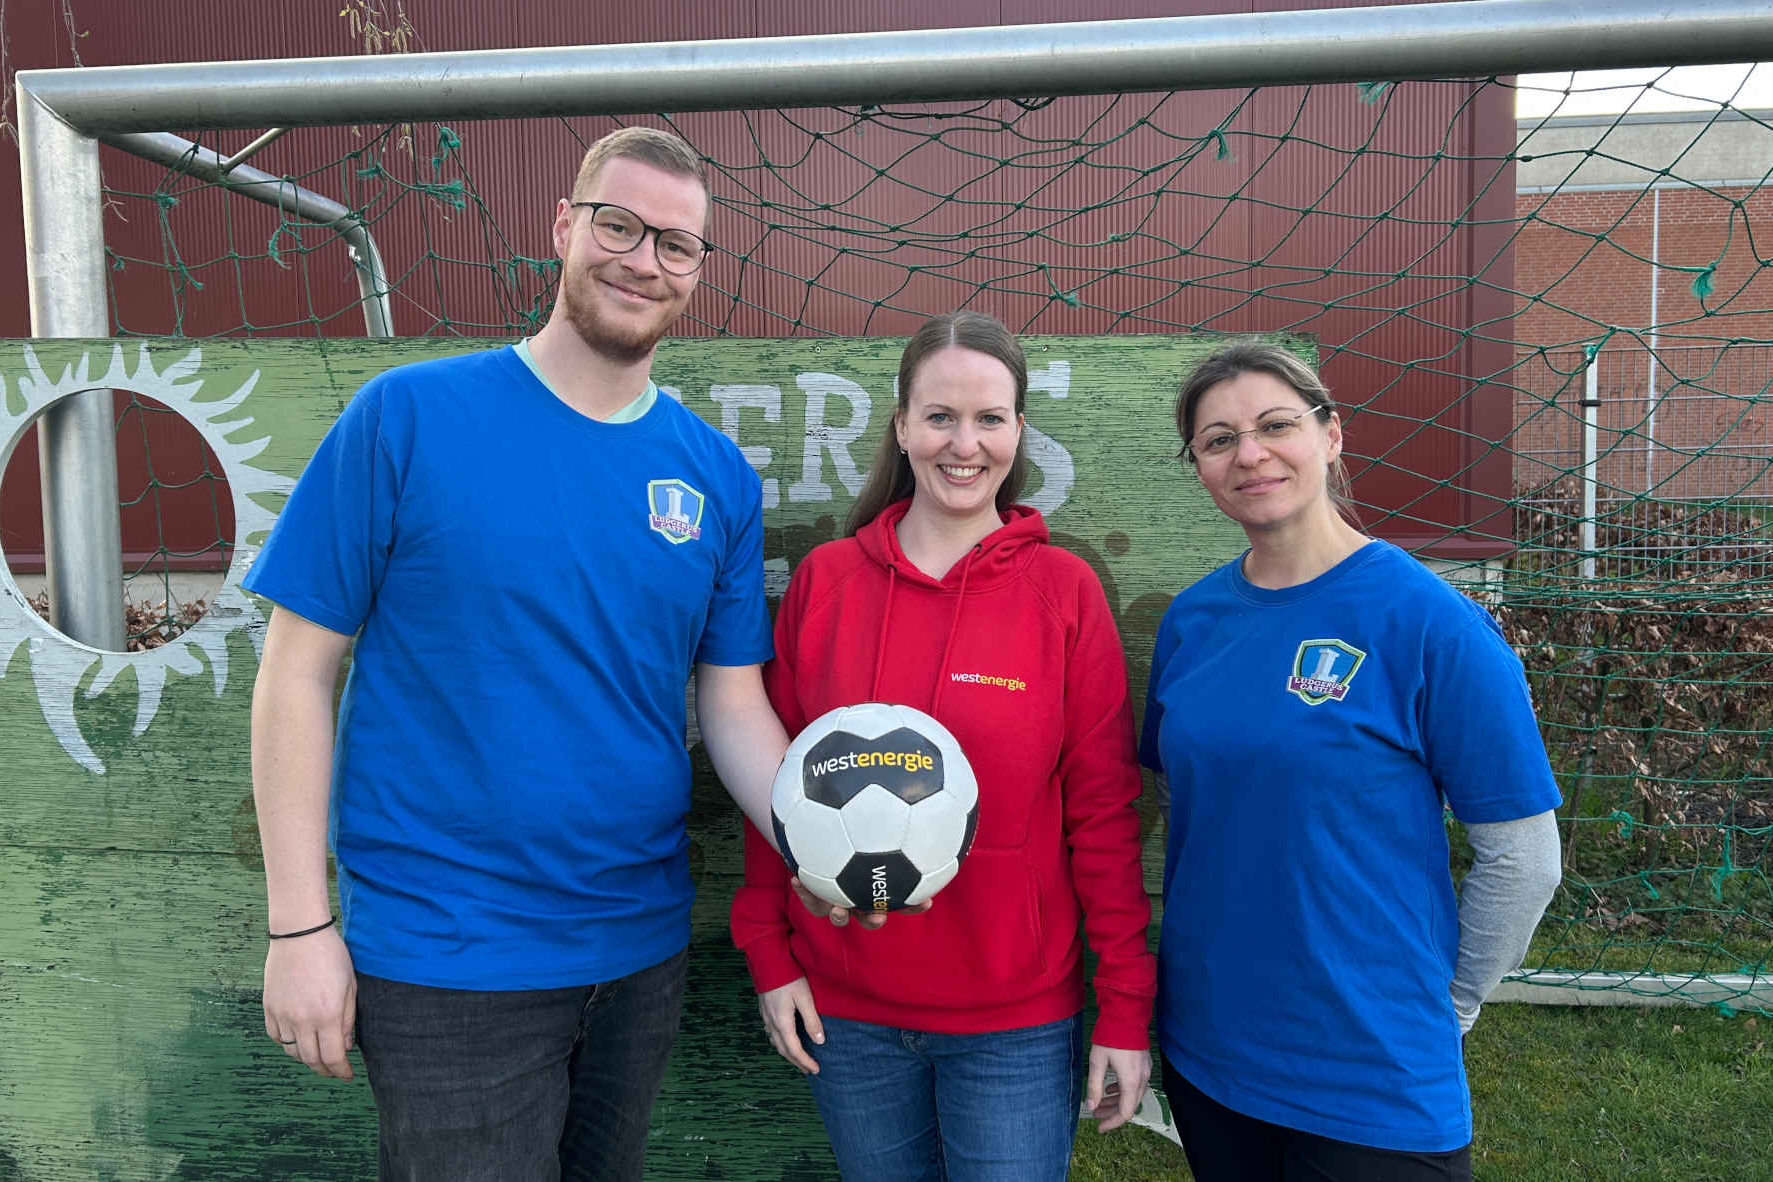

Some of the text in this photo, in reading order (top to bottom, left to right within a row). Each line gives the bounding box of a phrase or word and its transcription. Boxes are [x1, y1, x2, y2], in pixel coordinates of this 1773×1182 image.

[951, 672, 1026, 691] westenergie
[1294, 677, 1344, 691] LUDGERUS
[1299, 683, 1335, 694] CASTLE
[811, 750, 933, 777] westenergie
